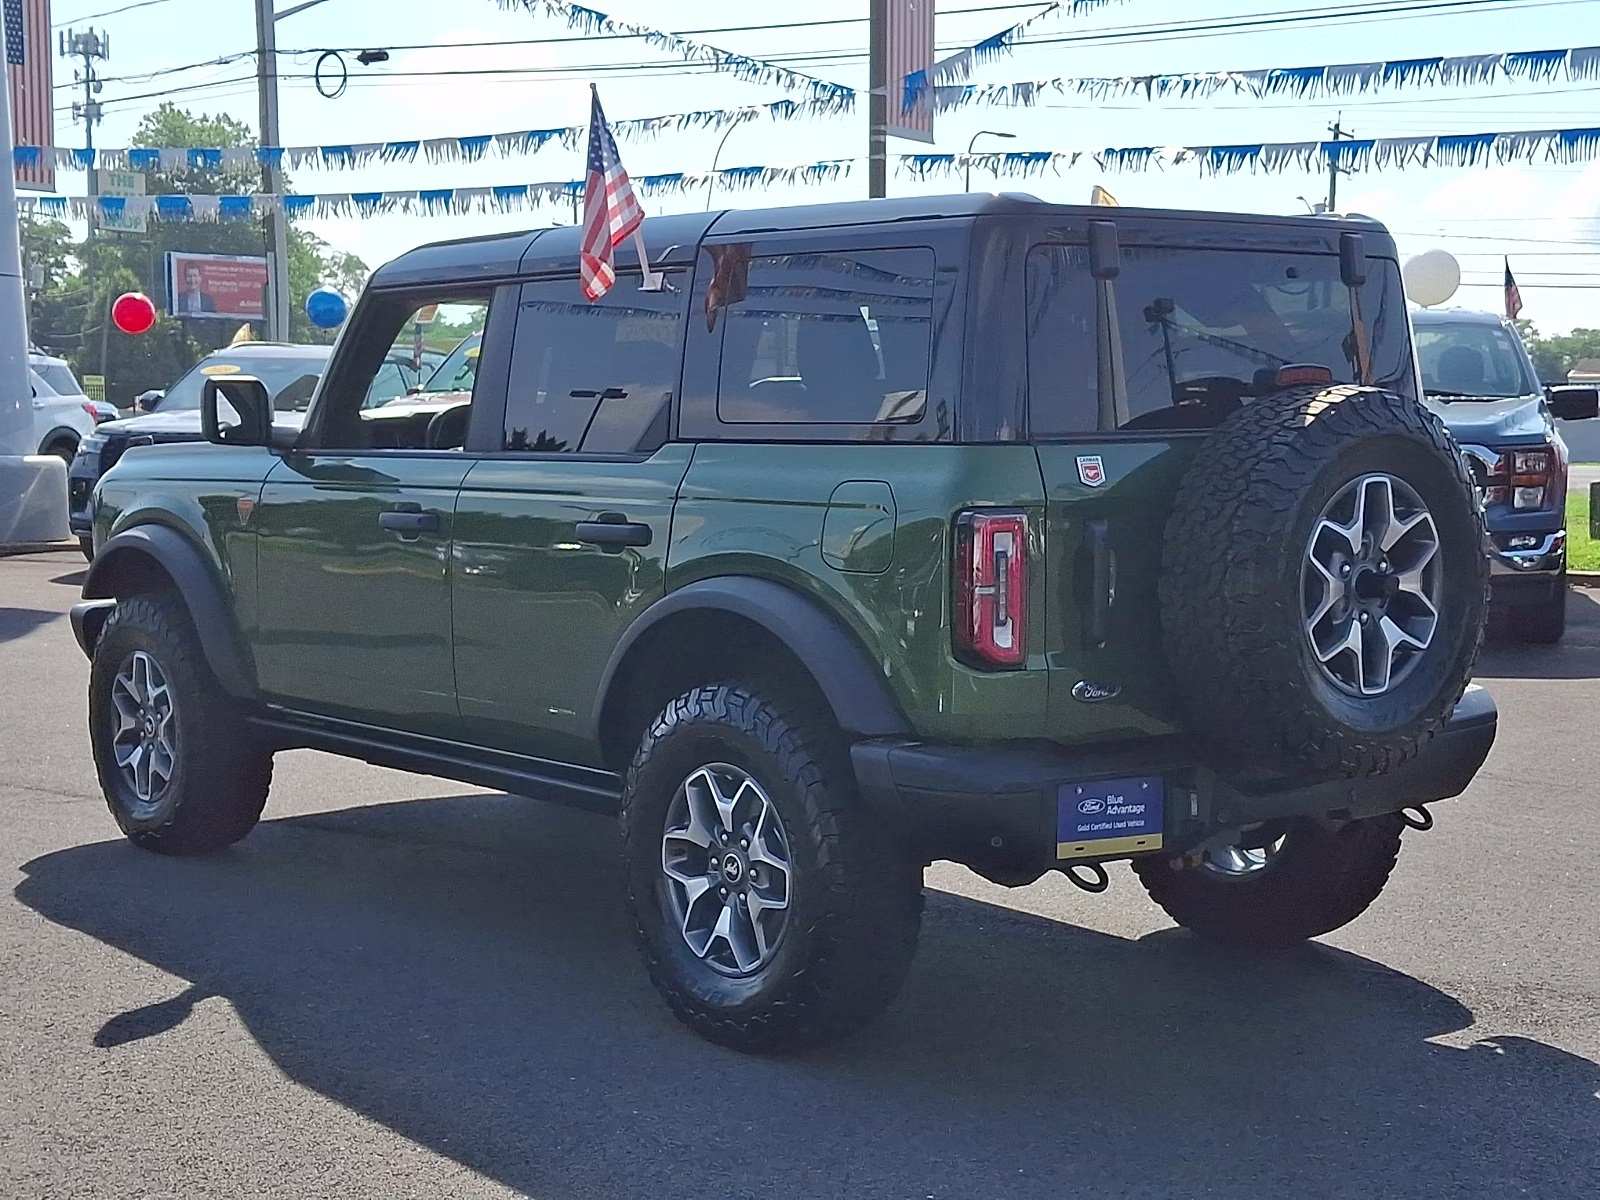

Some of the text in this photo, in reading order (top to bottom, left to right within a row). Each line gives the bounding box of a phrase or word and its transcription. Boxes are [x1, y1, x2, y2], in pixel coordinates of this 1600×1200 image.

[109, 174, 134, 187] THE
[1084, 683, 1110, 698] Ford
[1107, 795, 1123, 804] Blue
[1083, 801, 1100, 812] Ford
[1106, 804, 1145, 815] Advantage
[1077, 824, 1090, 832] Gold
[1091, 821, 1112, 831] Certified
[1113, 820, 1126, 828] Used
